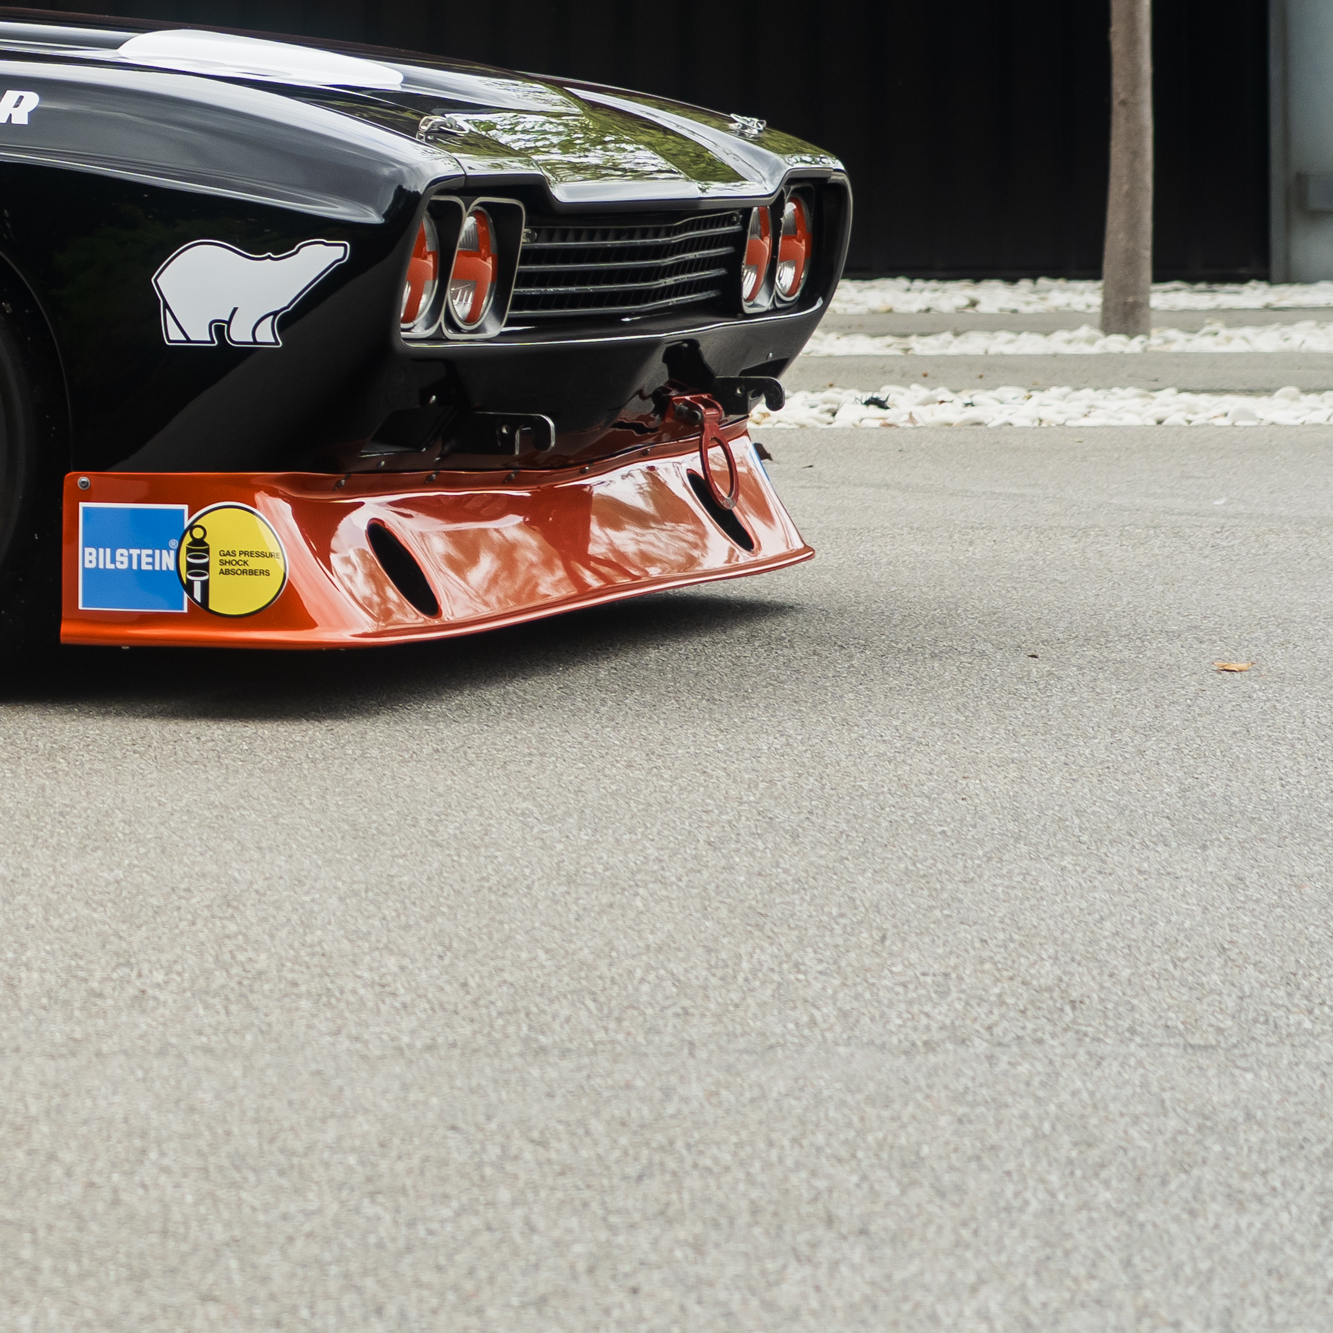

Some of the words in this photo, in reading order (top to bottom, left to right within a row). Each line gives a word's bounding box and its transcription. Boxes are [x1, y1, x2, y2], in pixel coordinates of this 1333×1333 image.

[83, 547, 176, 571] BILSTEIN
[218, 549, 237, 558] GAS
[238, 550, 282, 560] PRESSURE
[218, 558, 250, 567] SHOCK
[218, 568, 271, 577] ABSORBERS
